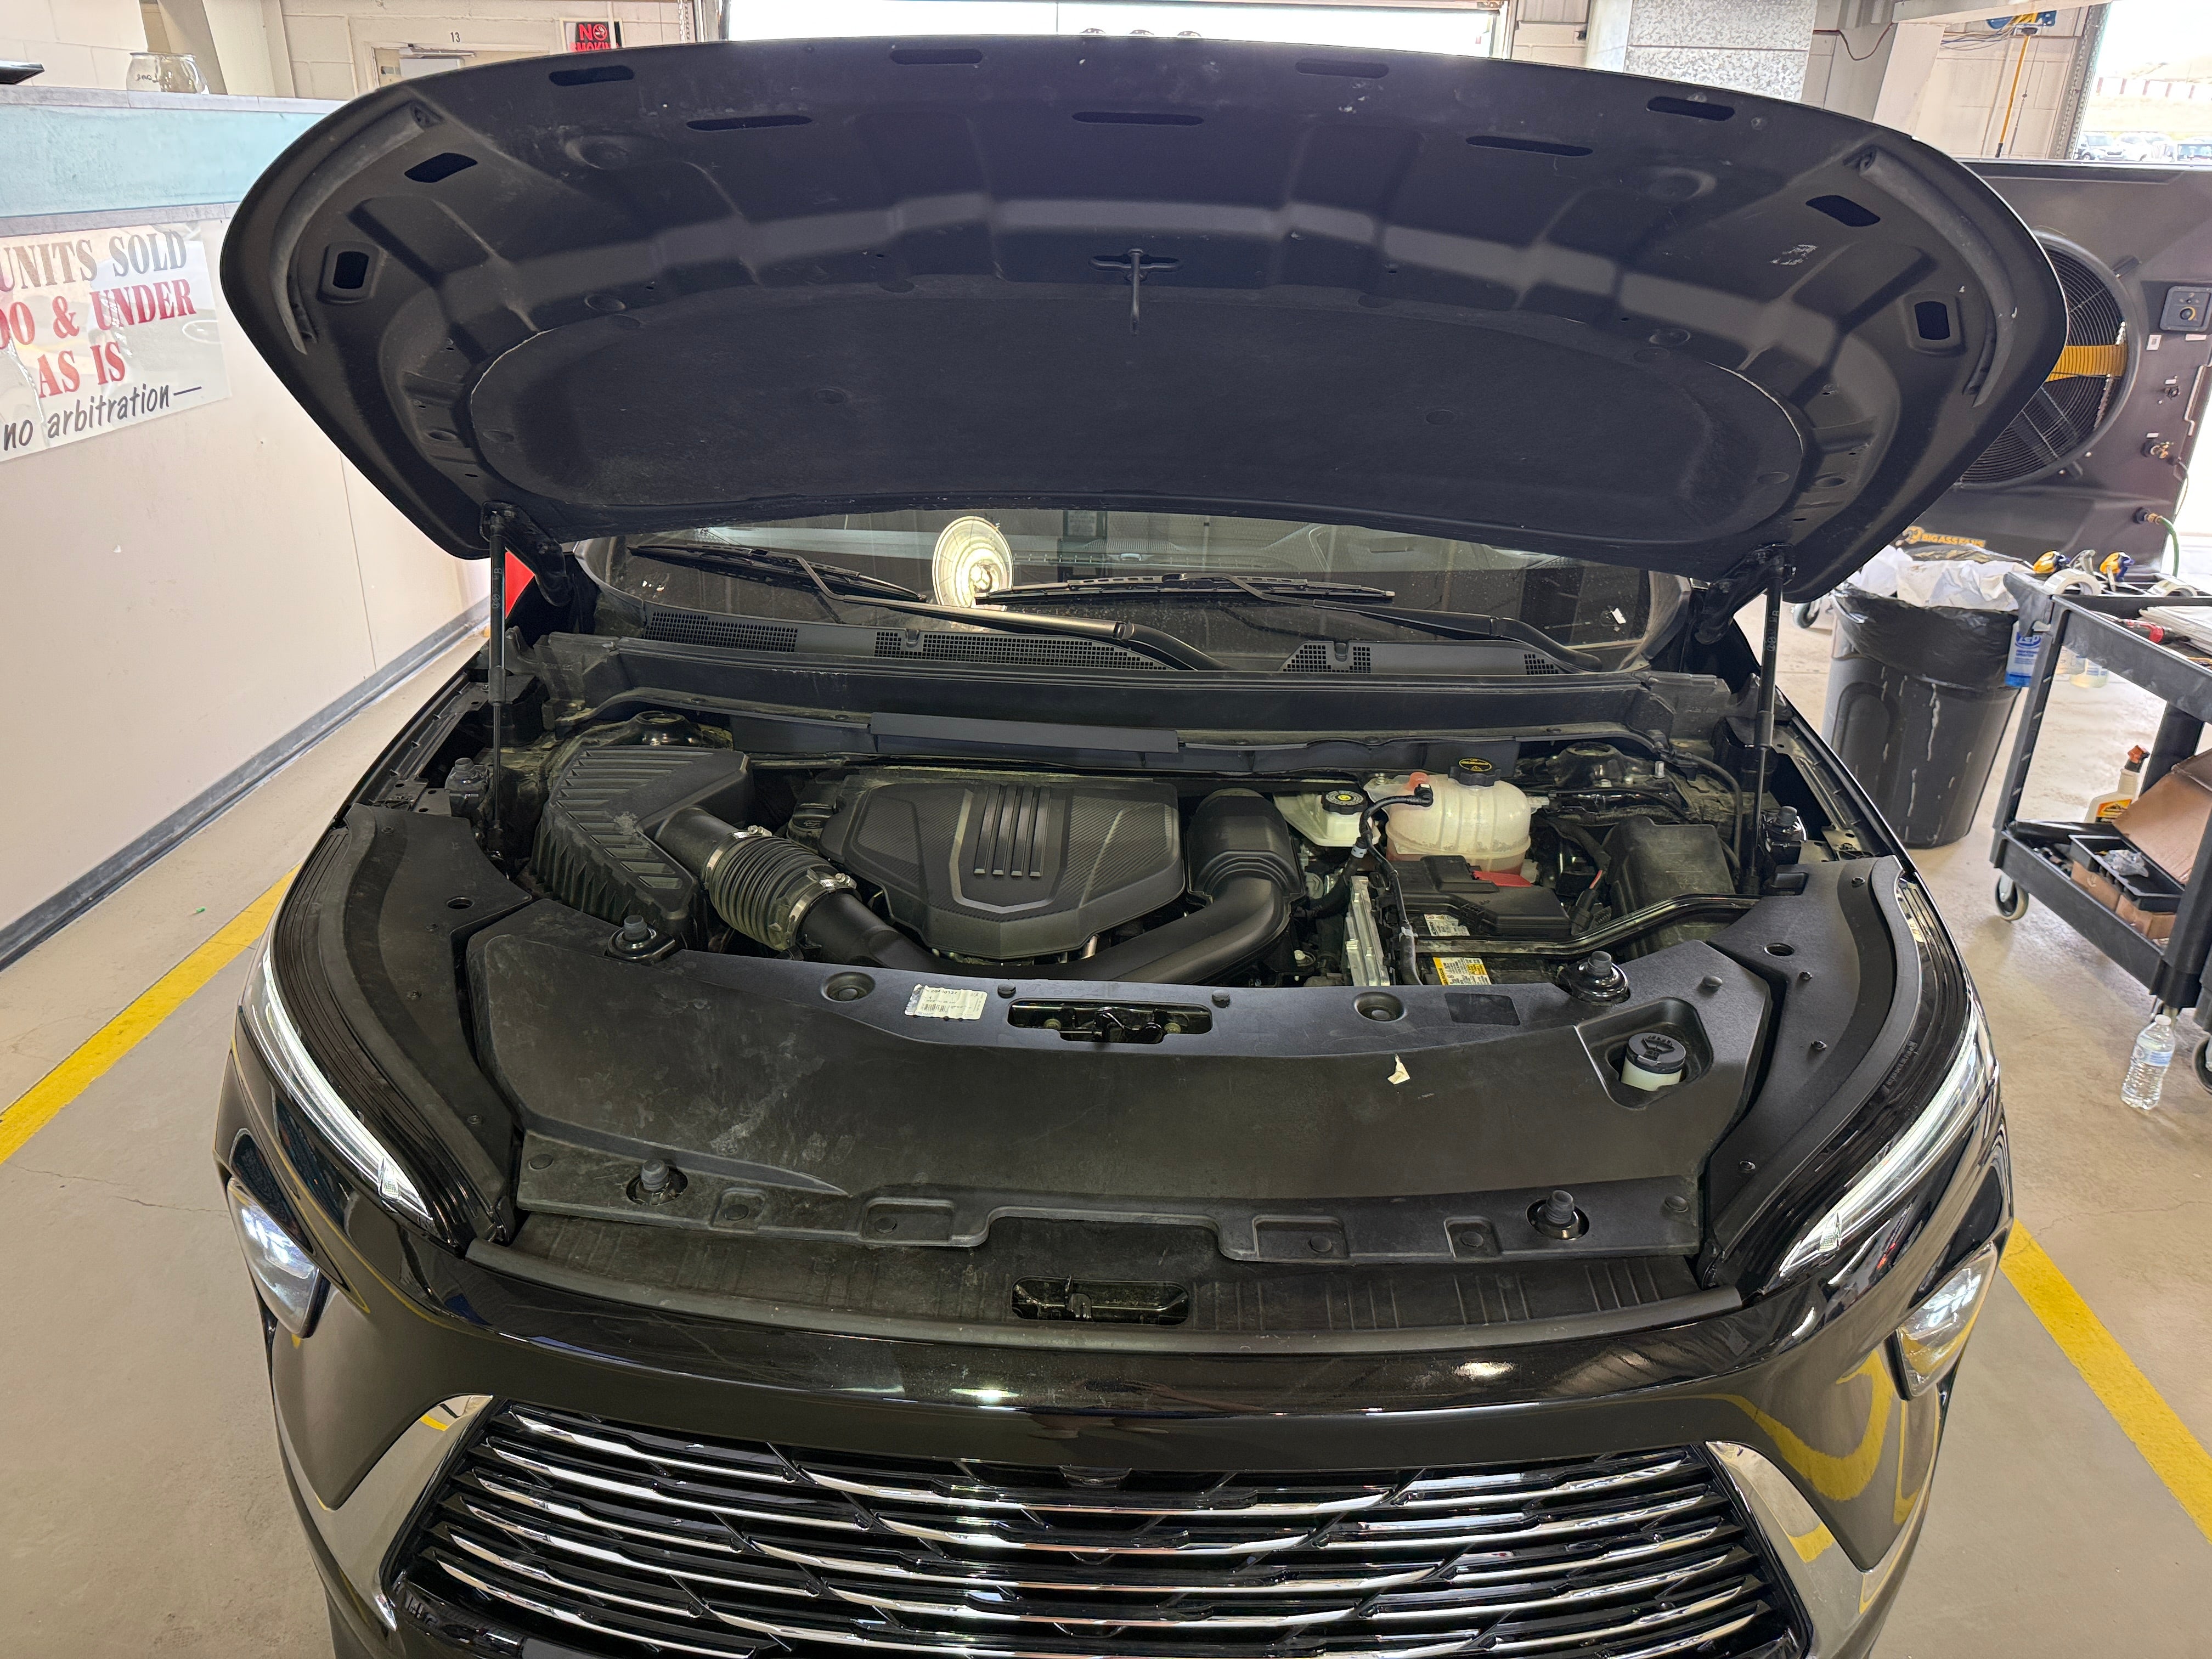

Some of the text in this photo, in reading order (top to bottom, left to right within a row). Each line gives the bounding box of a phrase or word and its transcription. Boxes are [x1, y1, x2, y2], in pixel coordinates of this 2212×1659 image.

[450, 31, 460, 43] 13
[579, 24, 607, 41] NO
[109, 229, 187, 277] SOLD
[52, 295, 80, 338] &
[89, 278, 197, 331] UNDER
[38, 341, 126, 398] AS IS
[4, 419, 33, 451] no
[1922, 533, 1938, 542] BIG
[1938, 535, 1958, 545] ASS
